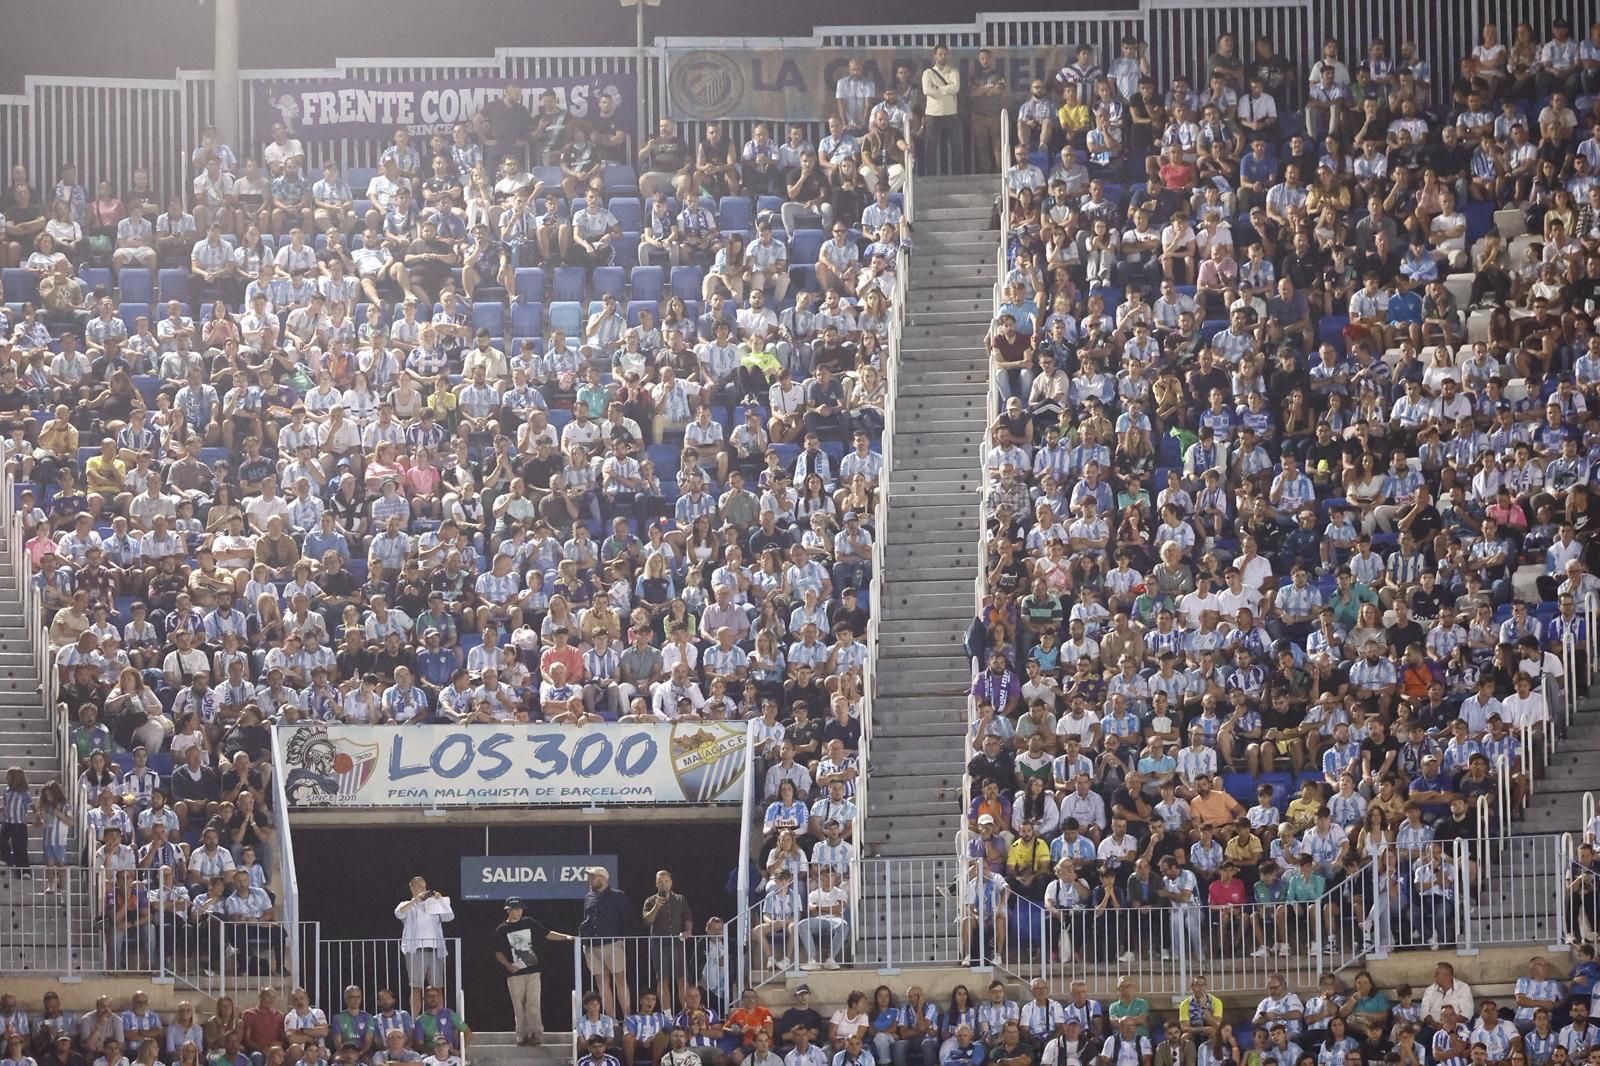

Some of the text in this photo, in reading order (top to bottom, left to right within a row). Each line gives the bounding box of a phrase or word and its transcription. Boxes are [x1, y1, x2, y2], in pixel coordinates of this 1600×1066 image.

[752, 58, 808, 92] LA
[301, 88, 414, 125] FRENTE
[407, 123, 453, 136] SINCE
[388, 732, 658, 781] LOS 300
[306, 794, 357, 802] SINCE 2011
[388, 786, 653, 798] PEÑA MALAGUISTA DE BARCELONA
[482, 866, 548, 883] SALIDA
